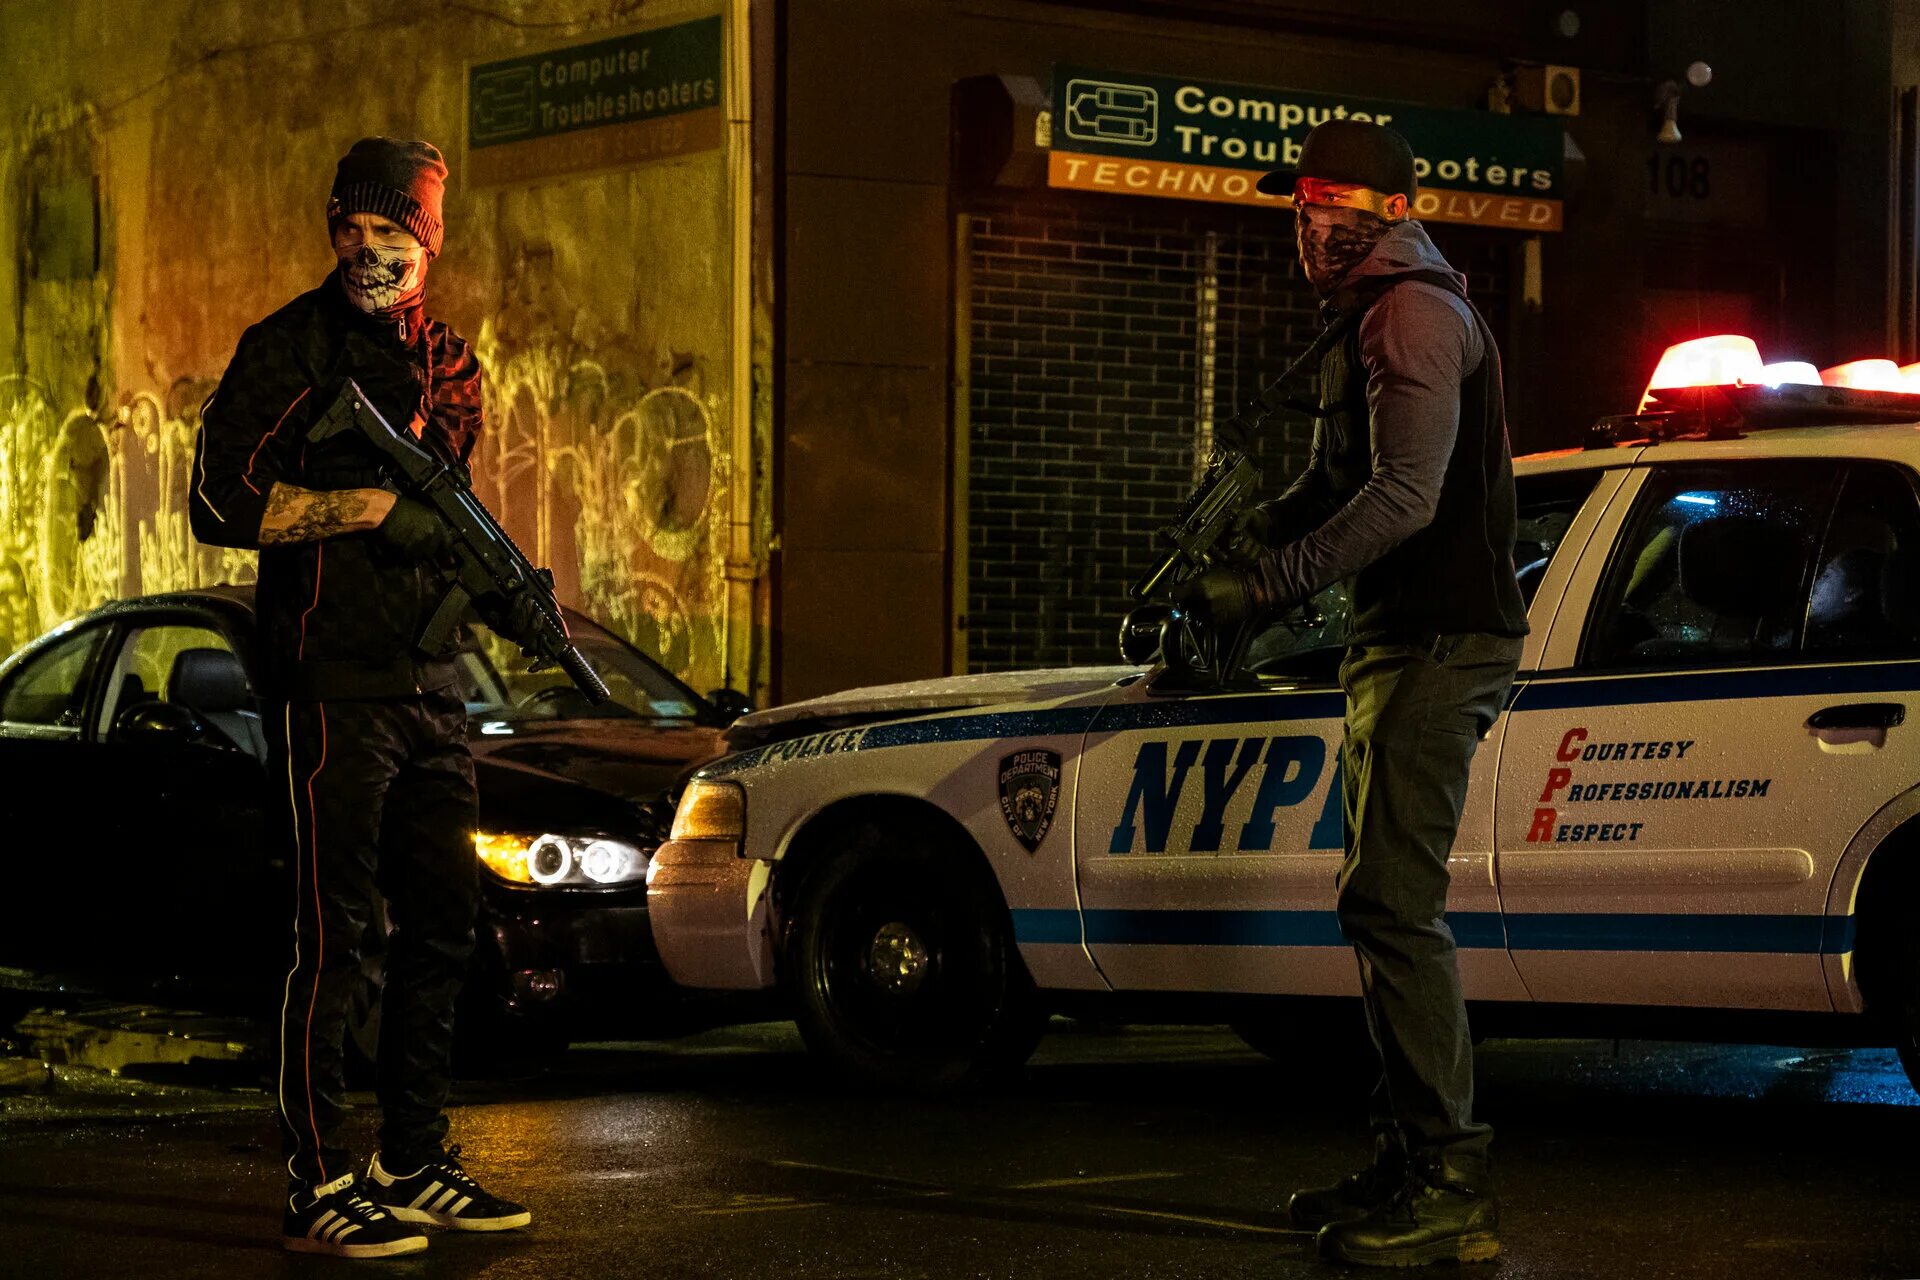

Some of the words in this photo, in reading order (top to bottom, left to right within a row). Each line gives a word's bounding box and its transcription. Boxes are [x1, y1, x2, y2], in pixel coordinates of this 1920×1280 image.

[539, 49, 650, 87] Computer
[540, 78, 715, 128] Troubleshooters
[1173, 124, 1553, 190] Troubooters
[1648, 153, 1711, 199] 108
[1065, 158, 1250, 196] TECHNO
[1414, 192, 1553, 225] OLVED
[763, 729, 865, 764] POLICE
[1013, 751, 1048, 767] POLICE
[1556, 728, 1694, 762] COURTESY
[1001, 763, 1059, 784] DEPARTMENT
[1538, 768, 1772, 803] PROFESSIONALISM
[1001, 796, 1015, 822] CITY
[1012, 824, 1024, 837] OF
[1035, 818, 1049, 841] NEW
[1045, 785, 1059, 814] YORK
[1525, 808, 1644, 842] RESPECT
